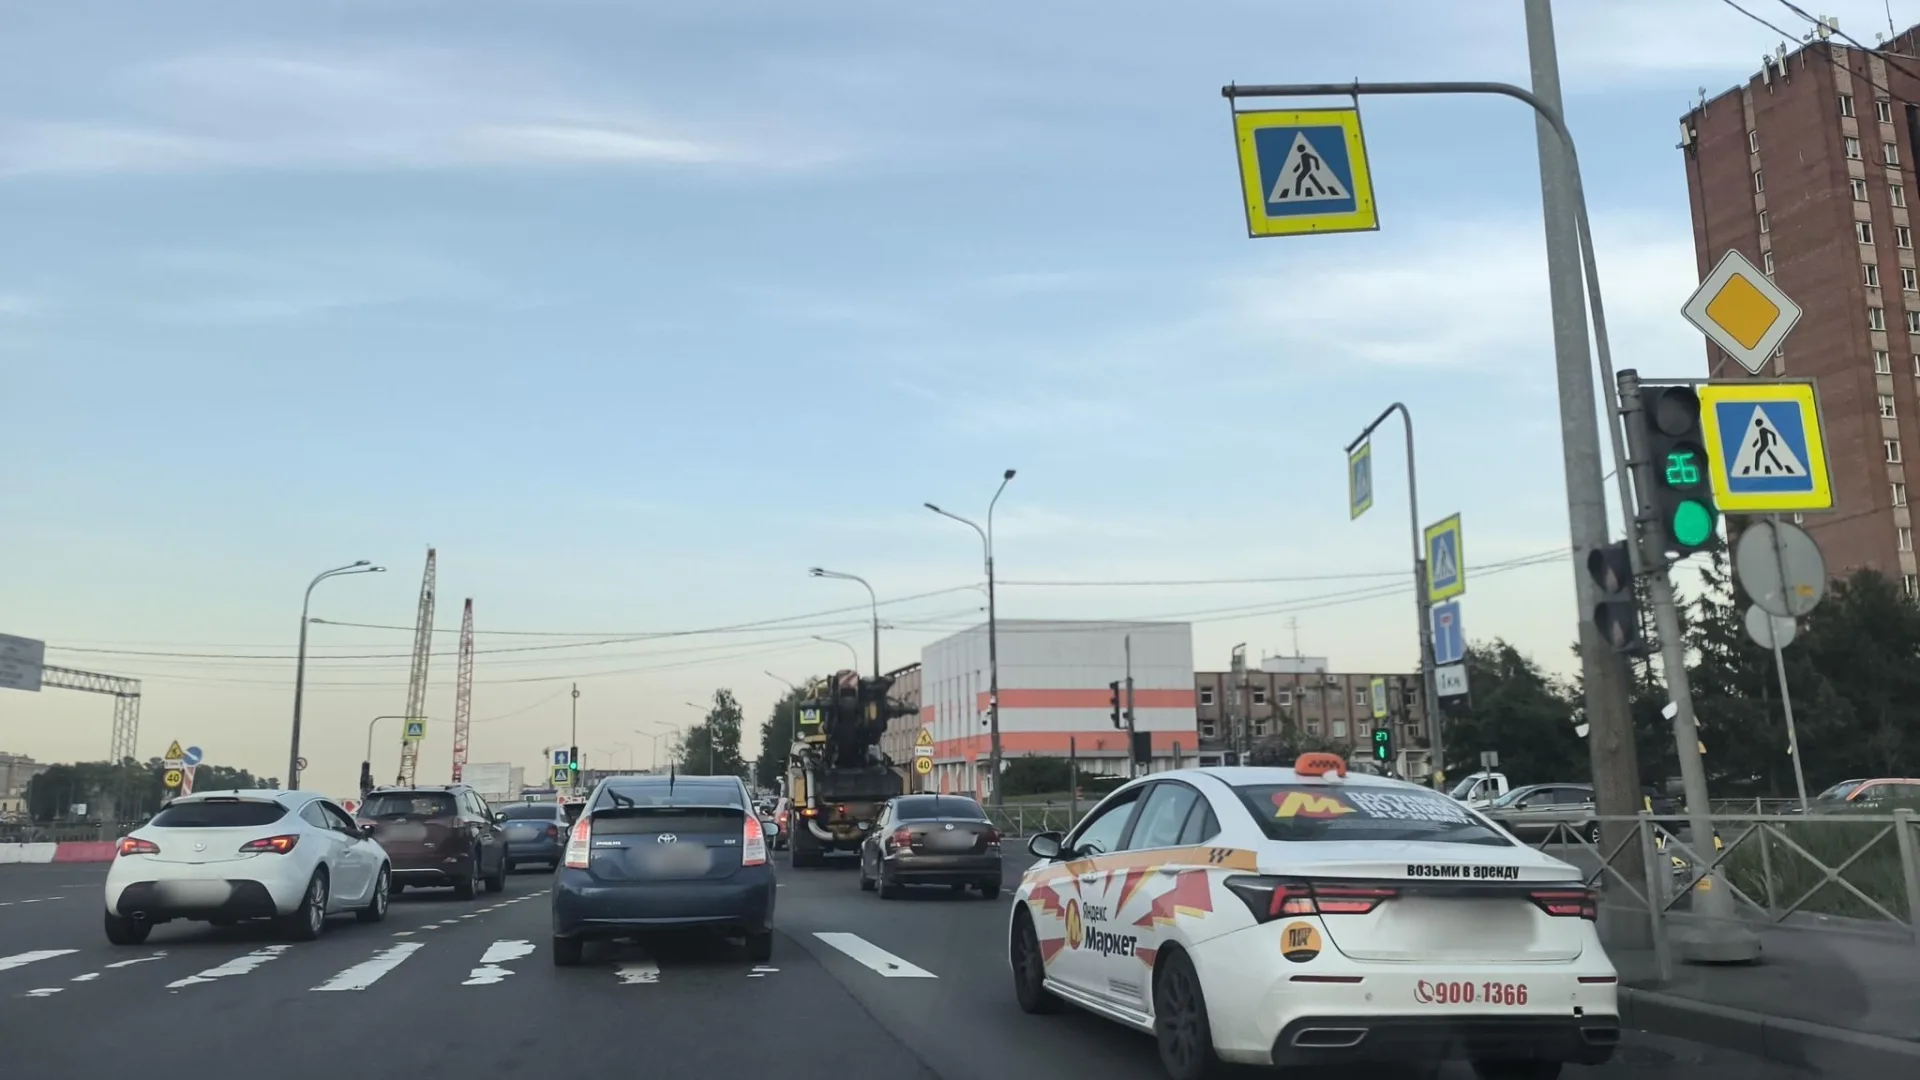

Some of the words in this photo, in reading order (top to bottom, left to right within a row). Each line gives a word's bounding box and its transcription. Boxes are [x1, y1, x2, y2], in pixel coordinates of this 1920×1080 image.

[1667, 453, 1699, 483] 26
[1375, 731, 1388, 741] 27
[918, 760, 930, 770] 40
[167, 773, 180, 783] 40
[1473, 865, 1520, 879] аренду
[1083, 902, 1107, 923] Яндекс
[1084, 926, 1137, 957] Маркет
[1435, 981, 1475, 1004] 900
[1482, 981, 1528, 1006] 1366
